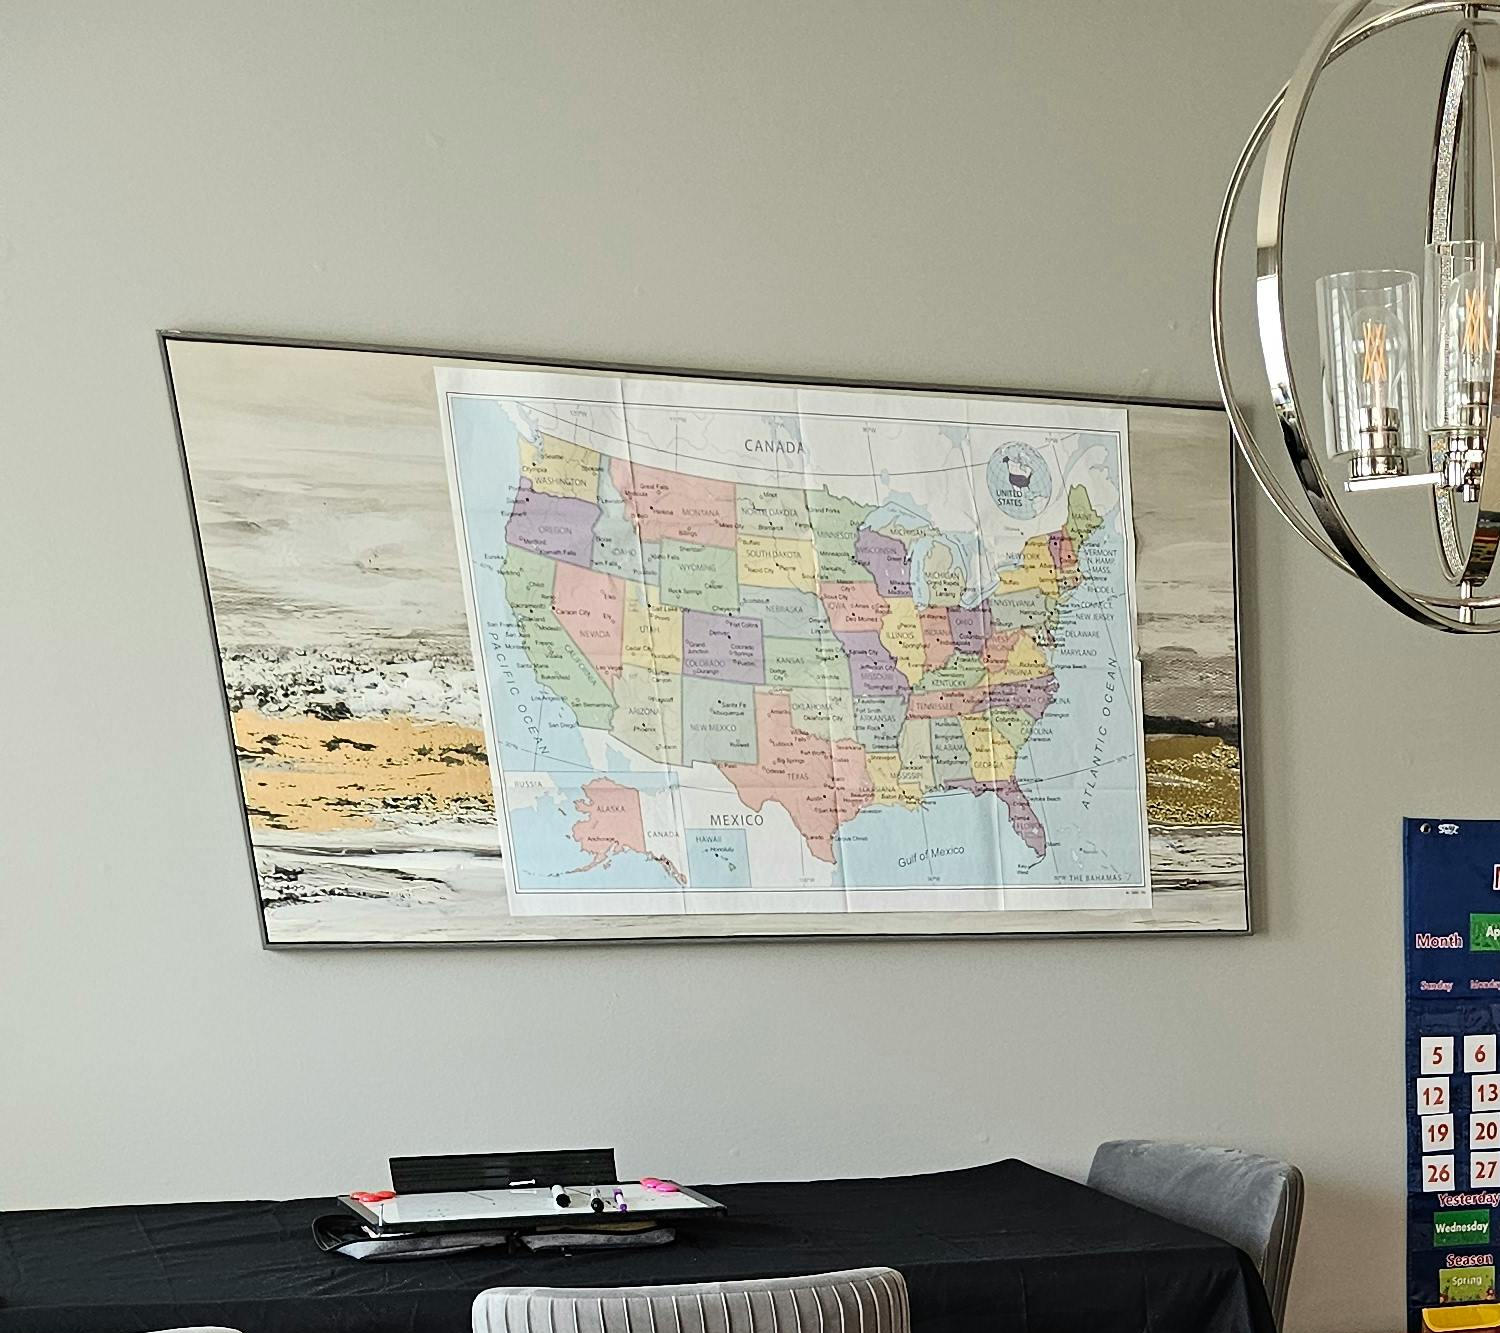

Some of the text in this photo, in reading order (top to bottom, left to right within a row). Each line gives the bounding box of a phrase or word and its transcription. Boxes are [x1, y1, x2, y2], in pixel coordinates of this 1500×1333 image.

[745, 439, 805, 453] CANADA
[535, 477, 587, 487] WASHINGTON
[996, 489, 1023, 498] UNITED
[998, 499, 1023, 507] STATES
[682, 508, 720, 517] MONTANA
[769, 509, 799, 517] DAKOTA
[538, 526, 572, 534] OREGON
[890, 529, 926, 537] MICHIGAN
[746, 549, 802, 558] SOUTH DAKOTA
[1006, 552, 1023, 560] NEW
[679, 564, 716, 572] WYOMING
[925, 572, 960, 580] MICHIGAN
[556, 608, 590, 617] Carson City
[1075, 613, 1115, 621] NEW JERSEY
[955, 618, 974, 626] OHIO
[580, 630, 611, 638] NEVADA
[886, 632, 915, 640] ILLINOIS
[1061, 649, 1097, 657] MARYLAND
[685, 659, 726, 667] COLORADO
[931, 679, 966, 687] KENTUCKY
[489, 632, 550, 755] PACIFIC OCEAN
[859, 714, 896, 722] ARKANSAS
[690, 724, 736, 732] NEW MEXICO
[1082, 656, 1118, 810] ATLANTIC OCEAN
[974, 761, 1004, 769] GEORGIA
[514, 780, 543, 788] RUSSIA
[596, 805, 625, 813] ALASKA
[709, 814, 764, 826] MEXICO
[648, 830, 679, 839] CANADA
[696, 835, 722, 843] HAWAII
[898, 846, 964, 868] Gulf of Mexico
[1086, 874, 1122, 882] BAHAMAS
[1415, 933, 1463, 949] Month
[1420, 980, 1453, 993] Sunday
[1432, 1046, 1443, 1065] 5
[1474, 1044, 1486, 1063] 6
[1423, 1087, 1444, 1106] 12
[1478, 1084, 1498, 1102] 13
[1428, 1124, 1449, 1142] 19
[1475, 1122, 1497, 1140] 20
[1428, 1164, 1450, 1182] 26
[1475, 1161, 1498, 1179] 27
[1435, 1221, 1489, 1235] Wednesday
[1446, 1254, 1493, 1268] Season
[1452, 1275, 1482, 1287] Spring
